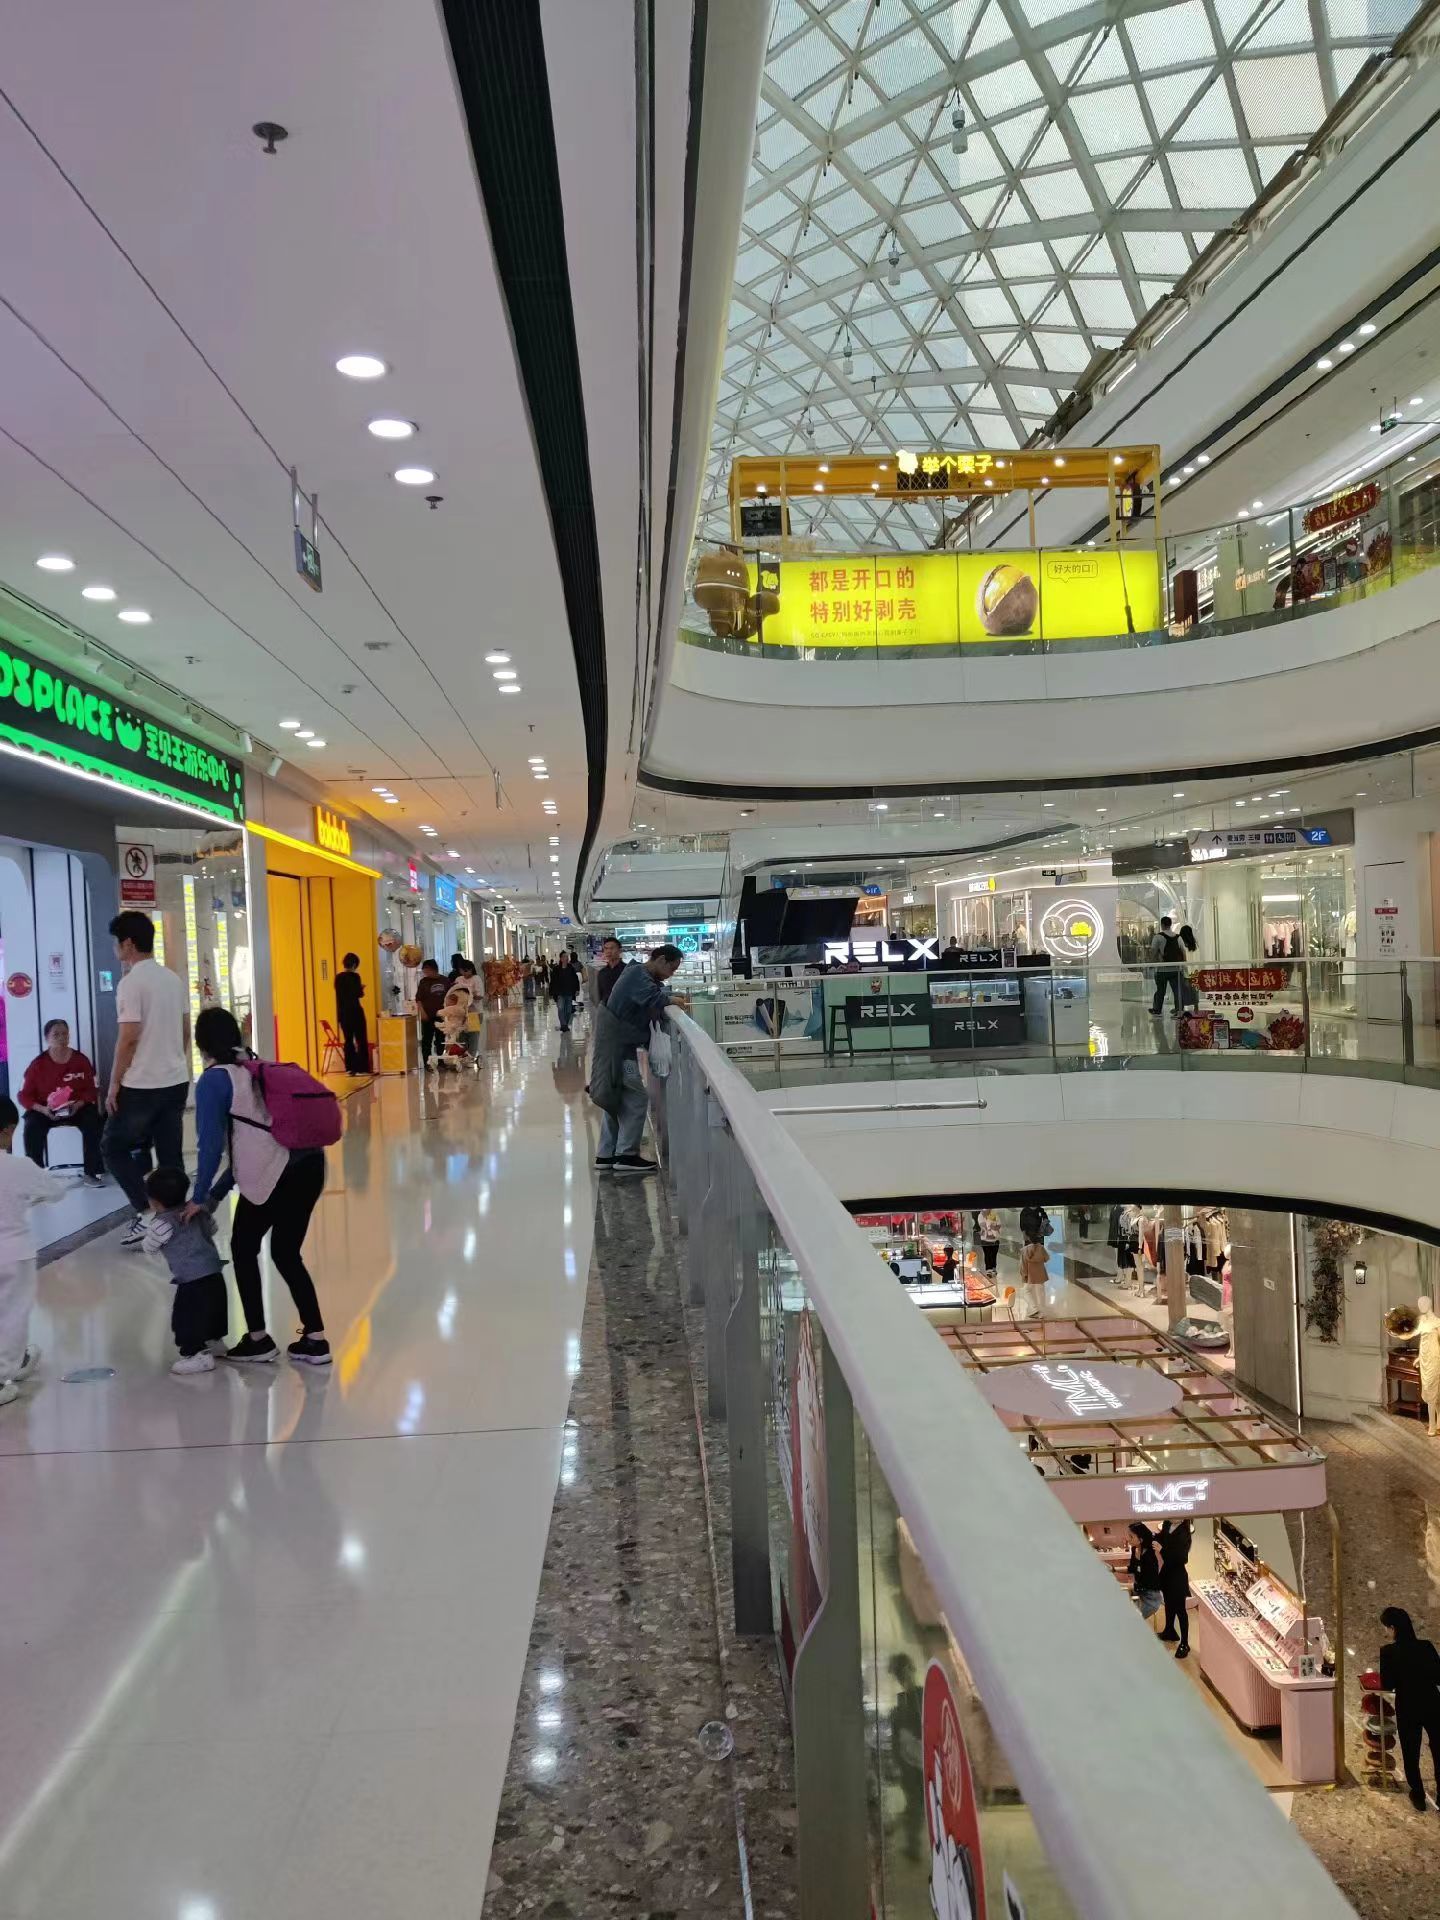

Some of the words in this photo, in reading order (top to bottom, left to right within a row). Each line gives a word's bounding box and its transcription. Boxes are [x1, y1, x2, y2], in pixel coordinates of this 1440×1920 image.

[921, 454, 993, 475] 举个栗子
[809, 566, 915, 592] 都是开口的
[810, 598, 916, 624] 特别好剥壳
[143, 722, 229, 792] 宝贝王游乐中心
[1311, 831, 1327, 841] 2F
[823, 937, 939, 965] RELX
[959, 953, 999, 963] RELX
[860, 1003, 916, 1019] RELX
[954, 1019, 999, 1031] RELX
